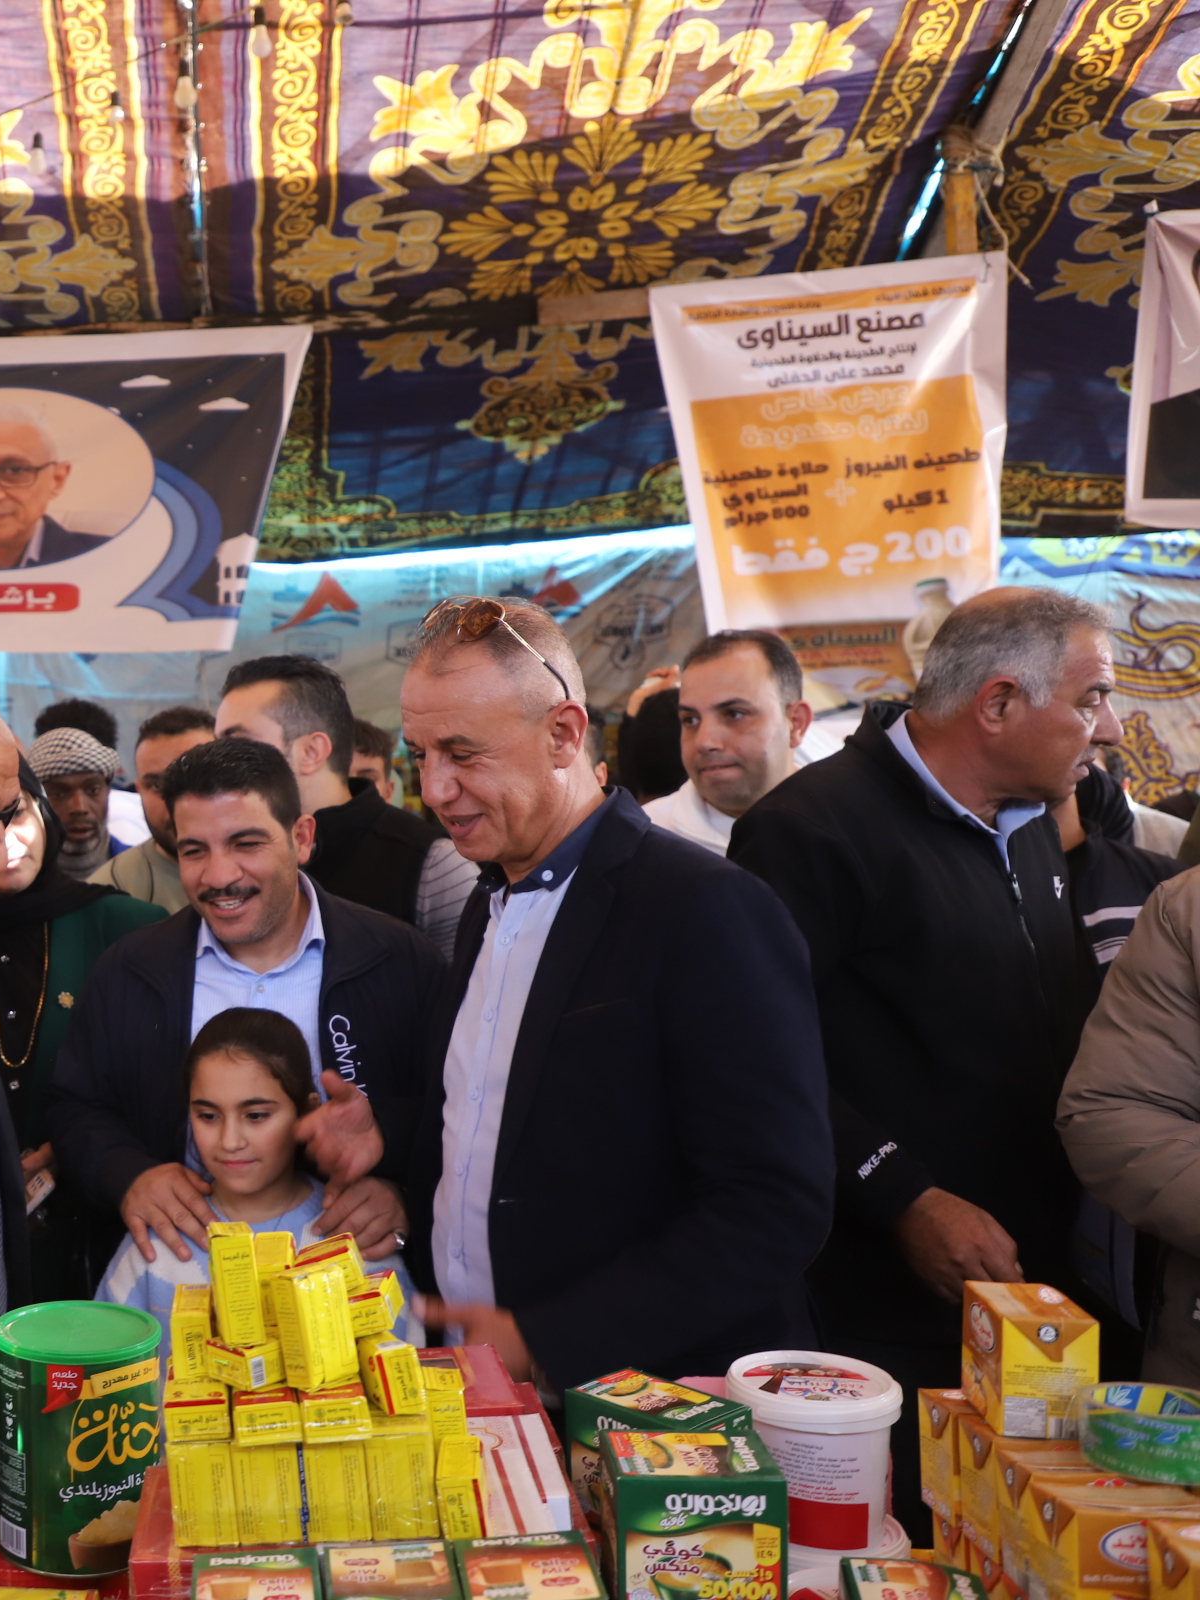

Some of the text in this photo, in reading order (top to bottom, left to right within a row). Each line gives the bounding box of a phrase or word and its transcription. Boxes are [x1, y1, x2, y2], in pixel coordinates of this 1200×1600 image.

[855, 310, 925, 343] مصنع
[861, 363, 905, 379] محمد
[759, 386, 910, 422] عرض خاص
[739, 409, 931, 451] لفترة محدودة
[703, 462, 830, 490] حلاوة طحينية
[845, 455, 909, 479] الفيروز
[723, 504, 811, 530] 800 جرام
[730, 524, 973, 577] 200 ج فقط
[329, 1014, 362, 1083] Calvin
[857, 1141, 898, 1180] NIKE-PRO
[51, 1370, 79, 1379] طعم
[51, 1380, 79, 1391] جديد
[102, 1369, 142, 1390] غير مهدرج
[58, 1473, 136, 1503] النيوزيلندي
[664, 1492, 767, 1517] بونجورنو
[659, 1512, 689, 1531] كافيه
[644, 1558, 701, 1577] ميكس
[724, 1568, 775, 1582] وإكسب
[698, 1579, 778, 1600] 50,000
